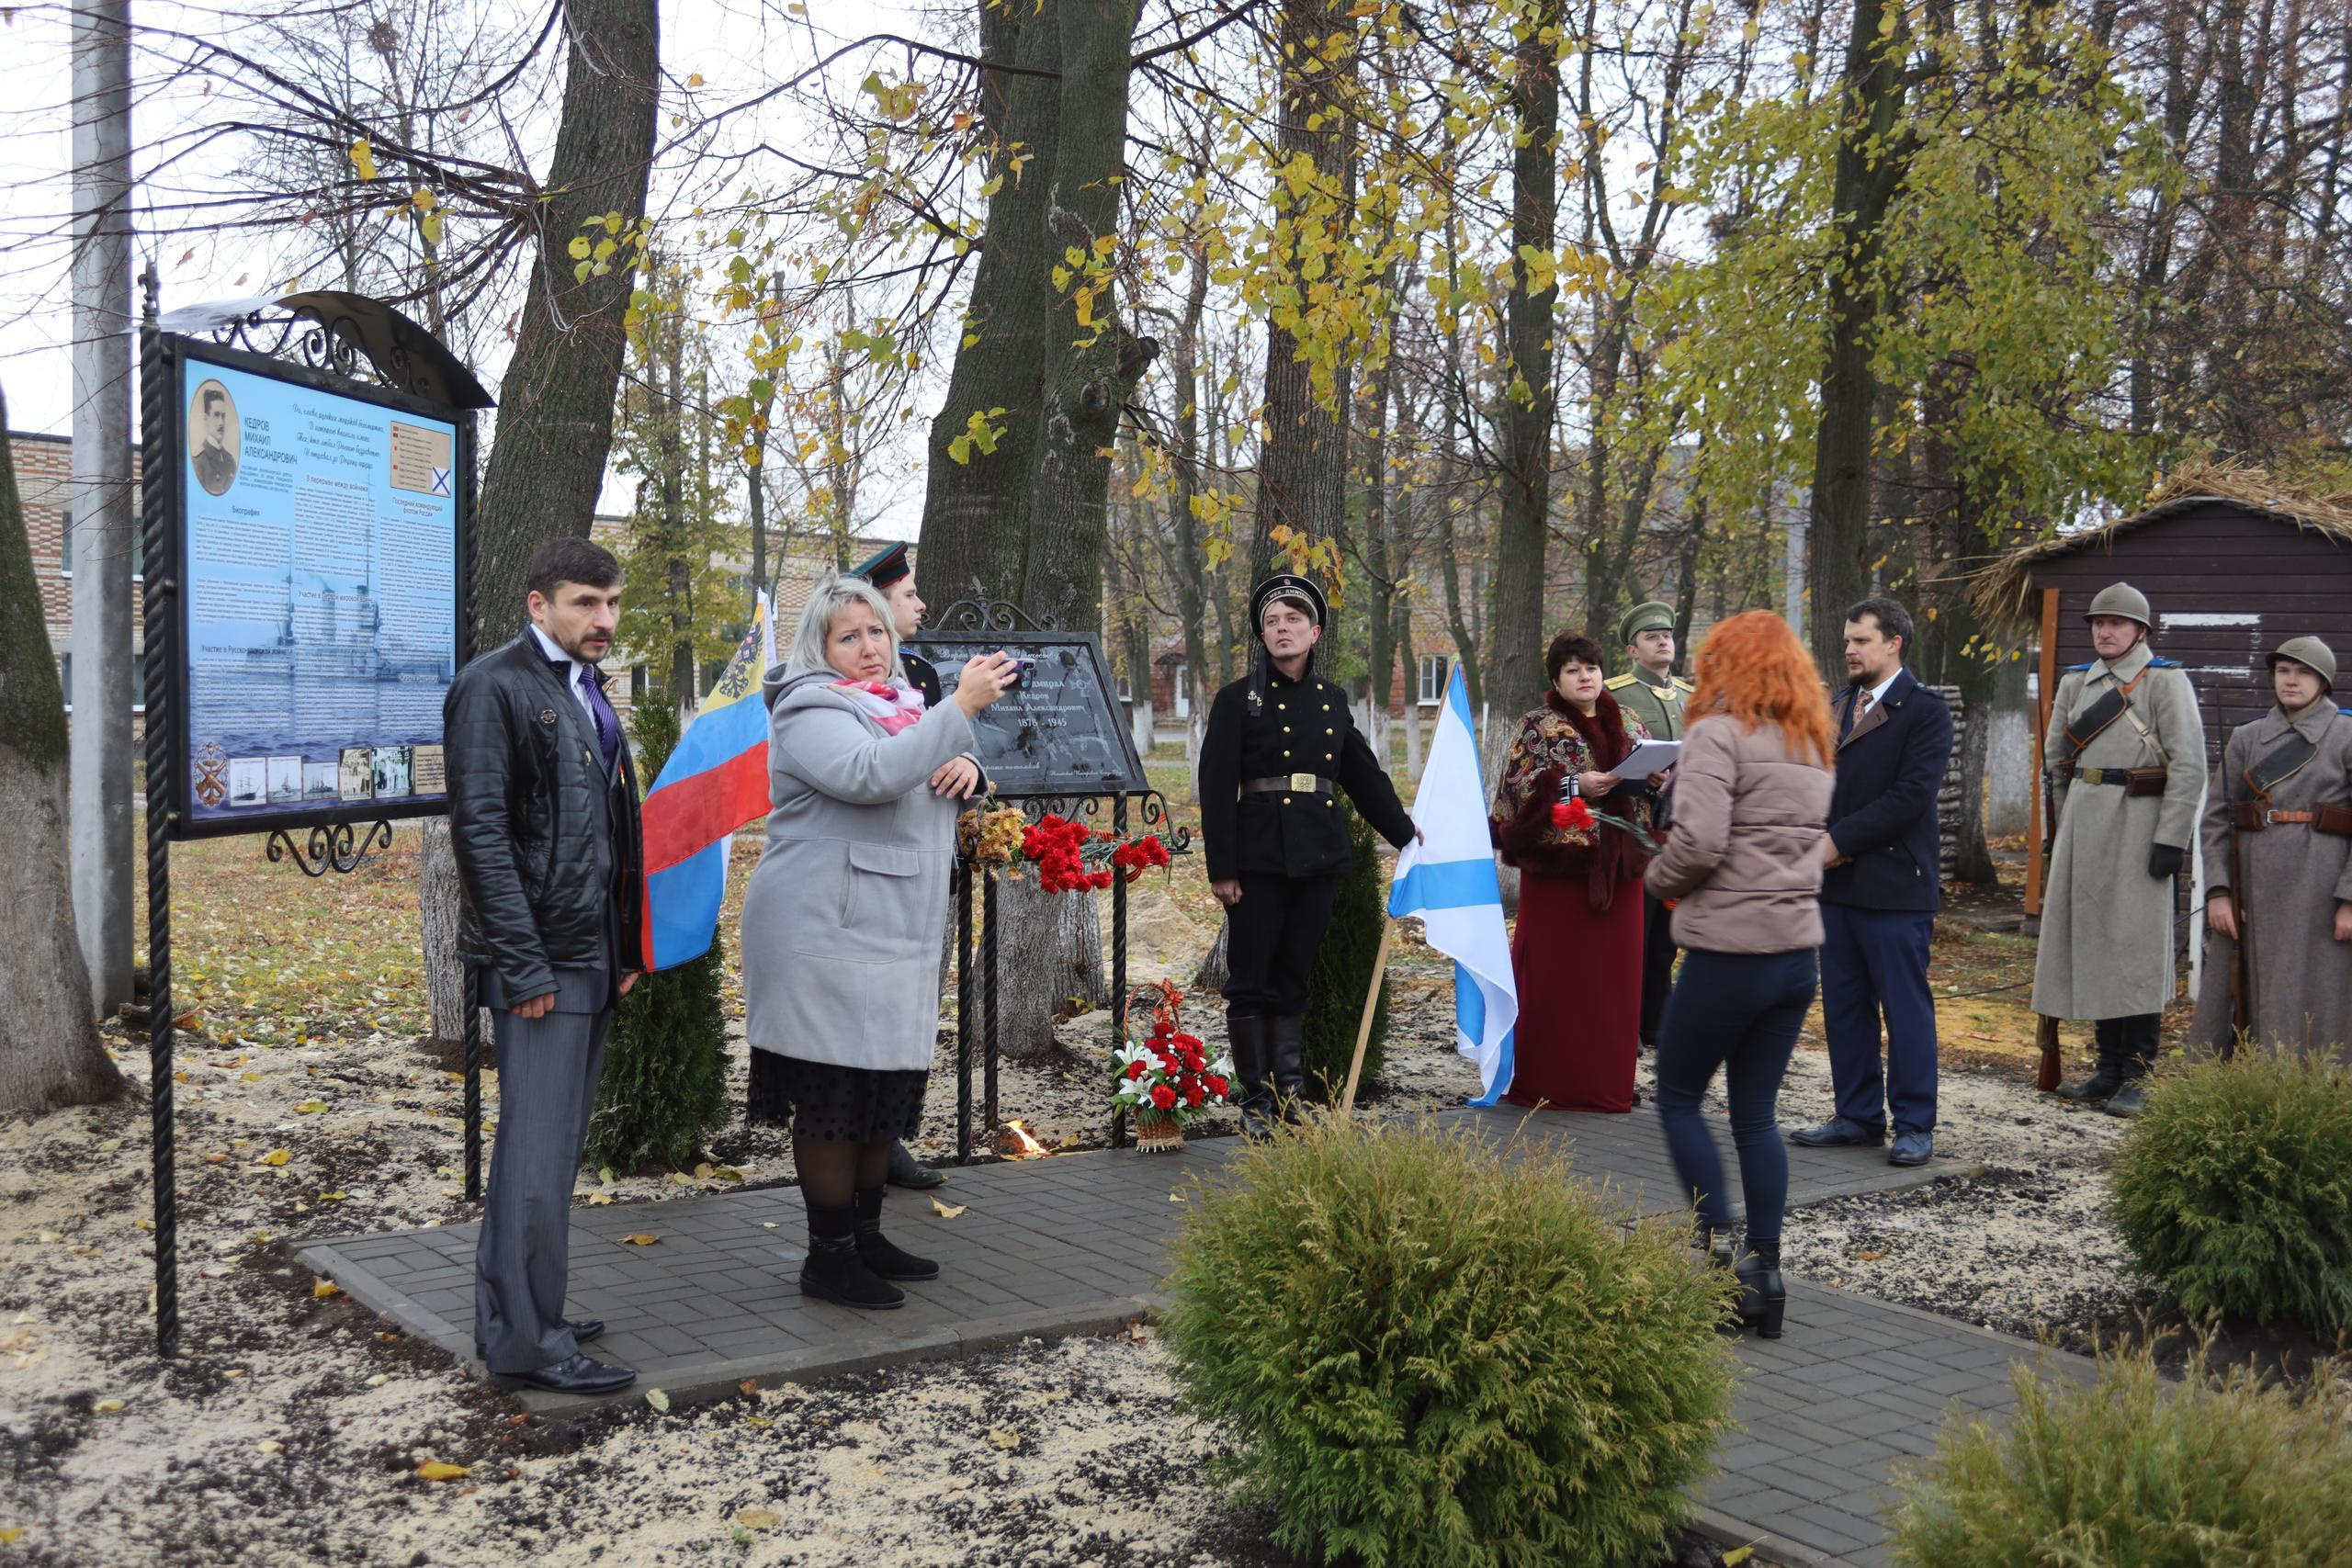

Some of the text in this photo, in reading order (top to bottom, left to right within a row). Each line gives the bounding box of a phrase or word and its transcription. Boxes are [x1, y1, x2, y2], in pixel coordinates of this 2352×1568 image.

[244, 417, 270, 432] КЕДРОВ
[244, 431, 271, 446] МИХАИЛ
[244, 446, 298, 464] АЛЕКСАНДРОВИЧ
[232, 505, 260, 515] Биография
[298, 589, 316, 599] Участие
[201, 644, 222, 653] Участие
[1020, 690, 1049, 700] Кедров
[990, 703, 1085, 713] Михаил Александрович
[1017, 718, 1038, 728] 1878
[1047, 718, 1067, 728] 1945
